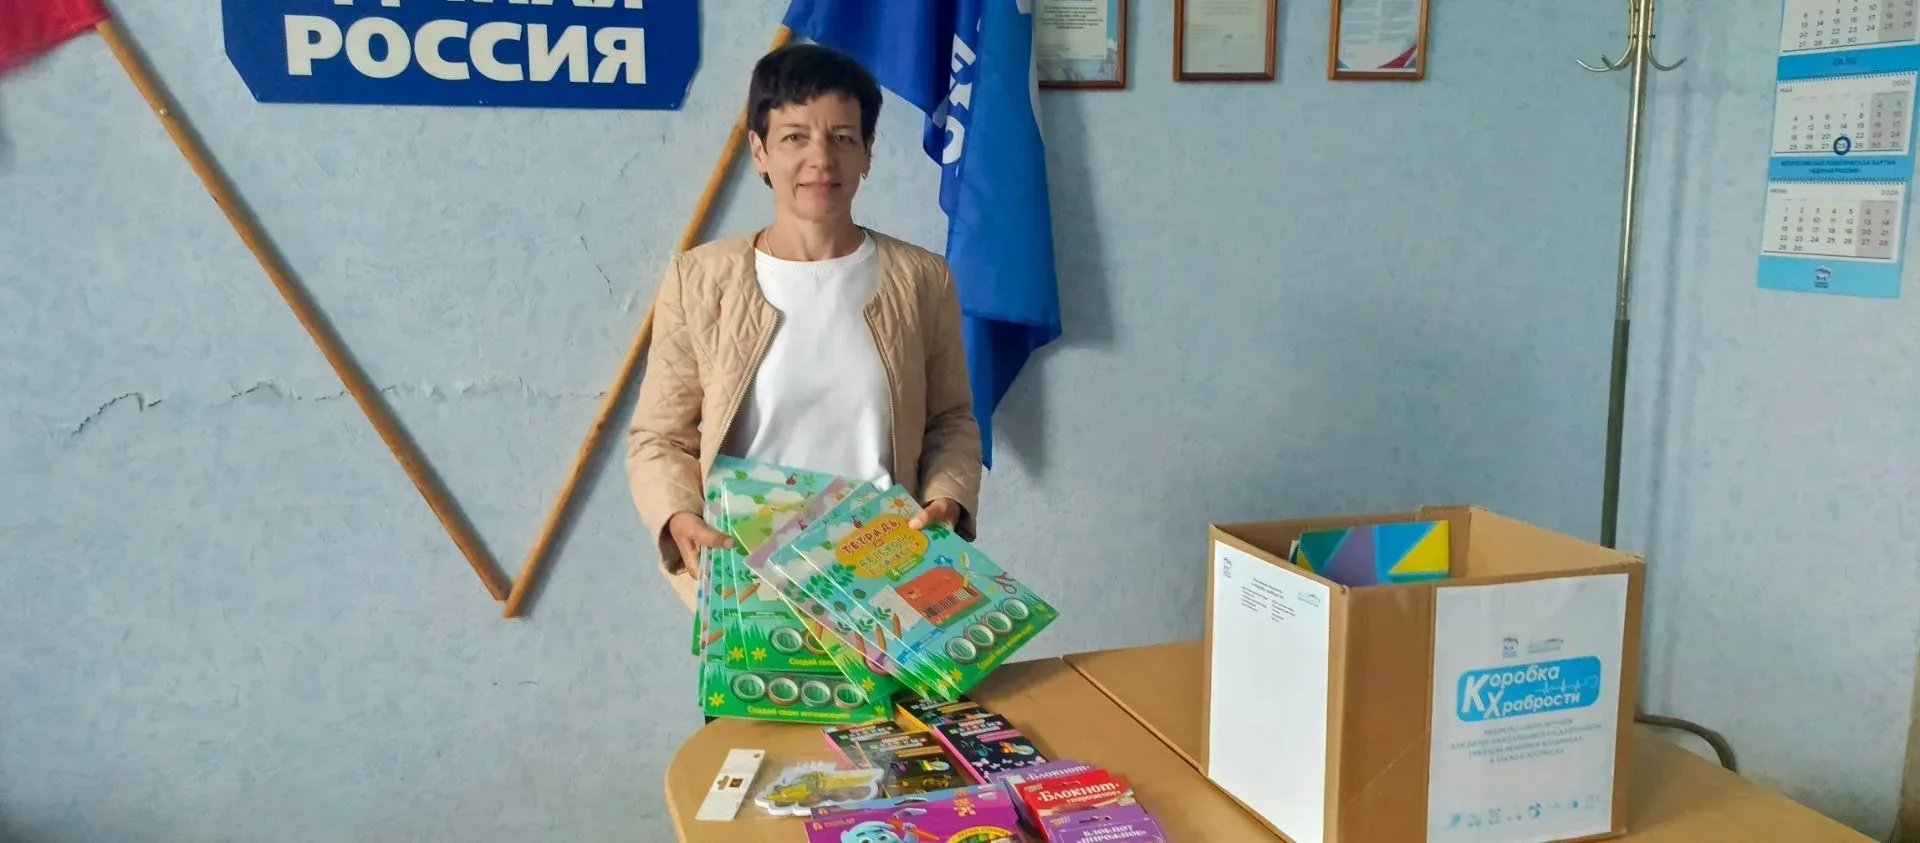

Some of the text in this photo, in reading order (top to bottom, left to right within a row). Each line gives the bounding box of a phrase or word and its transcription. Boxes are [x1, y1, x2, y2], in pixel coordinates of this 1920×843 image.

[284, 14, 647, 85] РОССИЯ
[841, 519, 901, 555] ТЕТРАДЬ
[1462, 665, 1560, 713] Коробка
[1482, 690, 1581, 719] Храбрости
